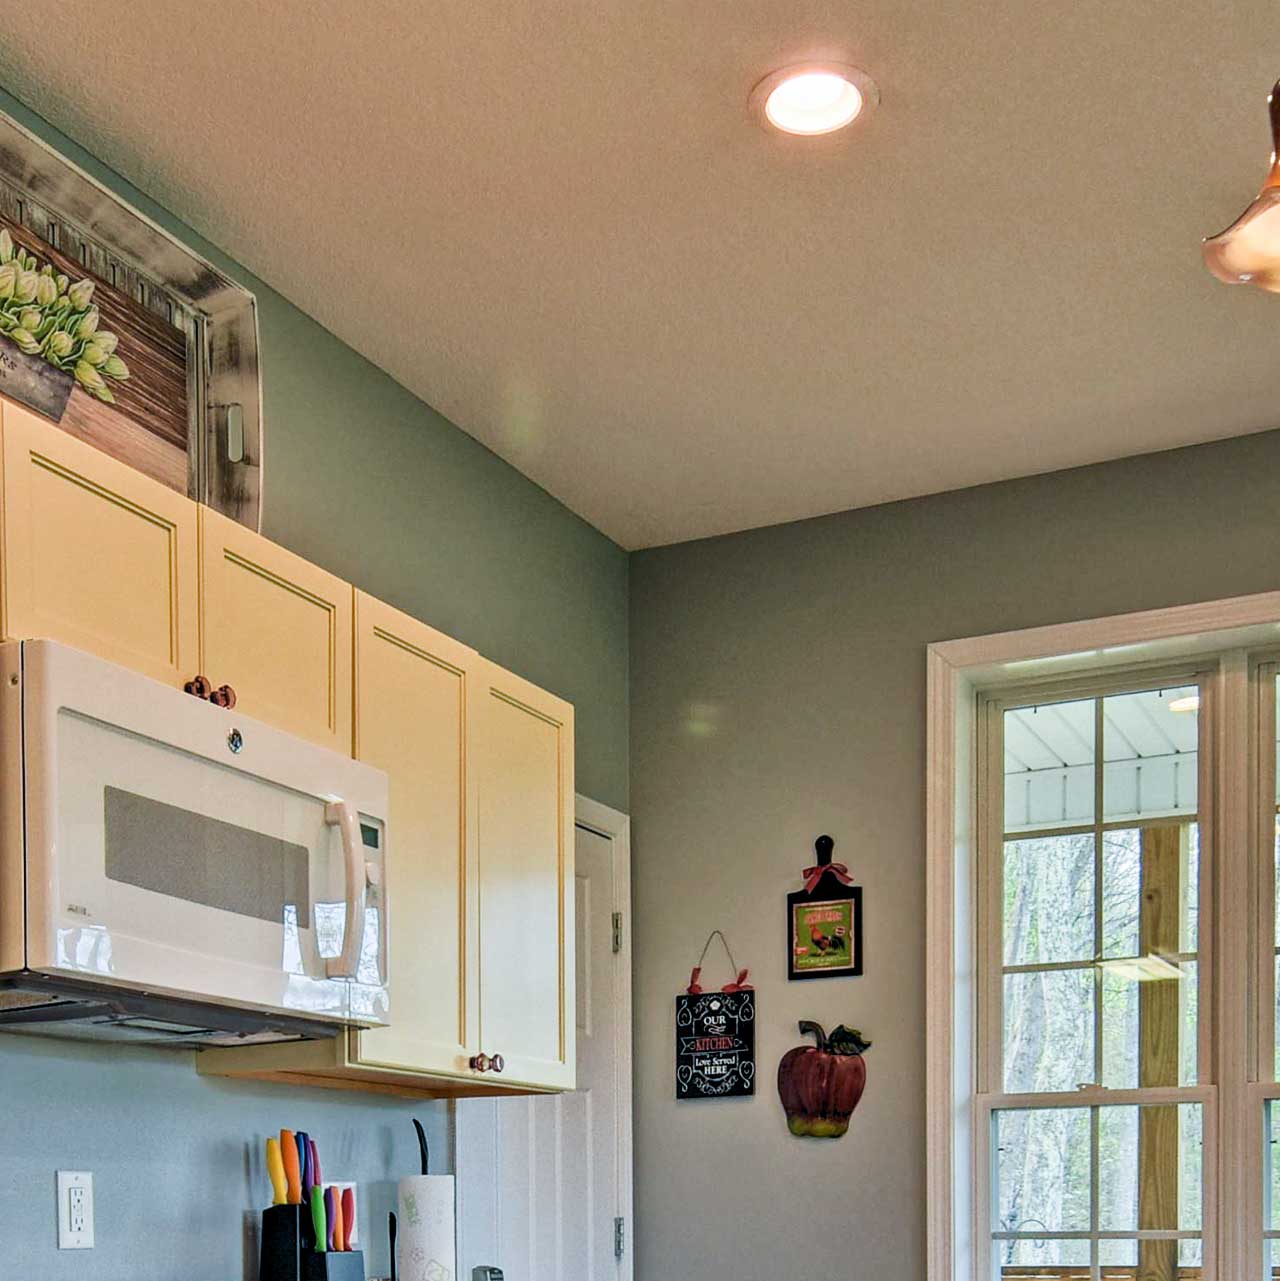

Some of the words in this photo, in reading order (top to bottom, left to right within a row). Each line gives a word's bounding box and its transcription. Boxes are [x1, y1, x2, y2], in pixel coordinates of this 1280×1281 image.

[703, 1015, 726, 1025] OUR
[695, 1036, 733, 1051] KITCHEN
[695, 1058, 711, 1067] Love
[712, 1055, 736, 1066] Served
[704, 1065, 728, 1075] HERE
